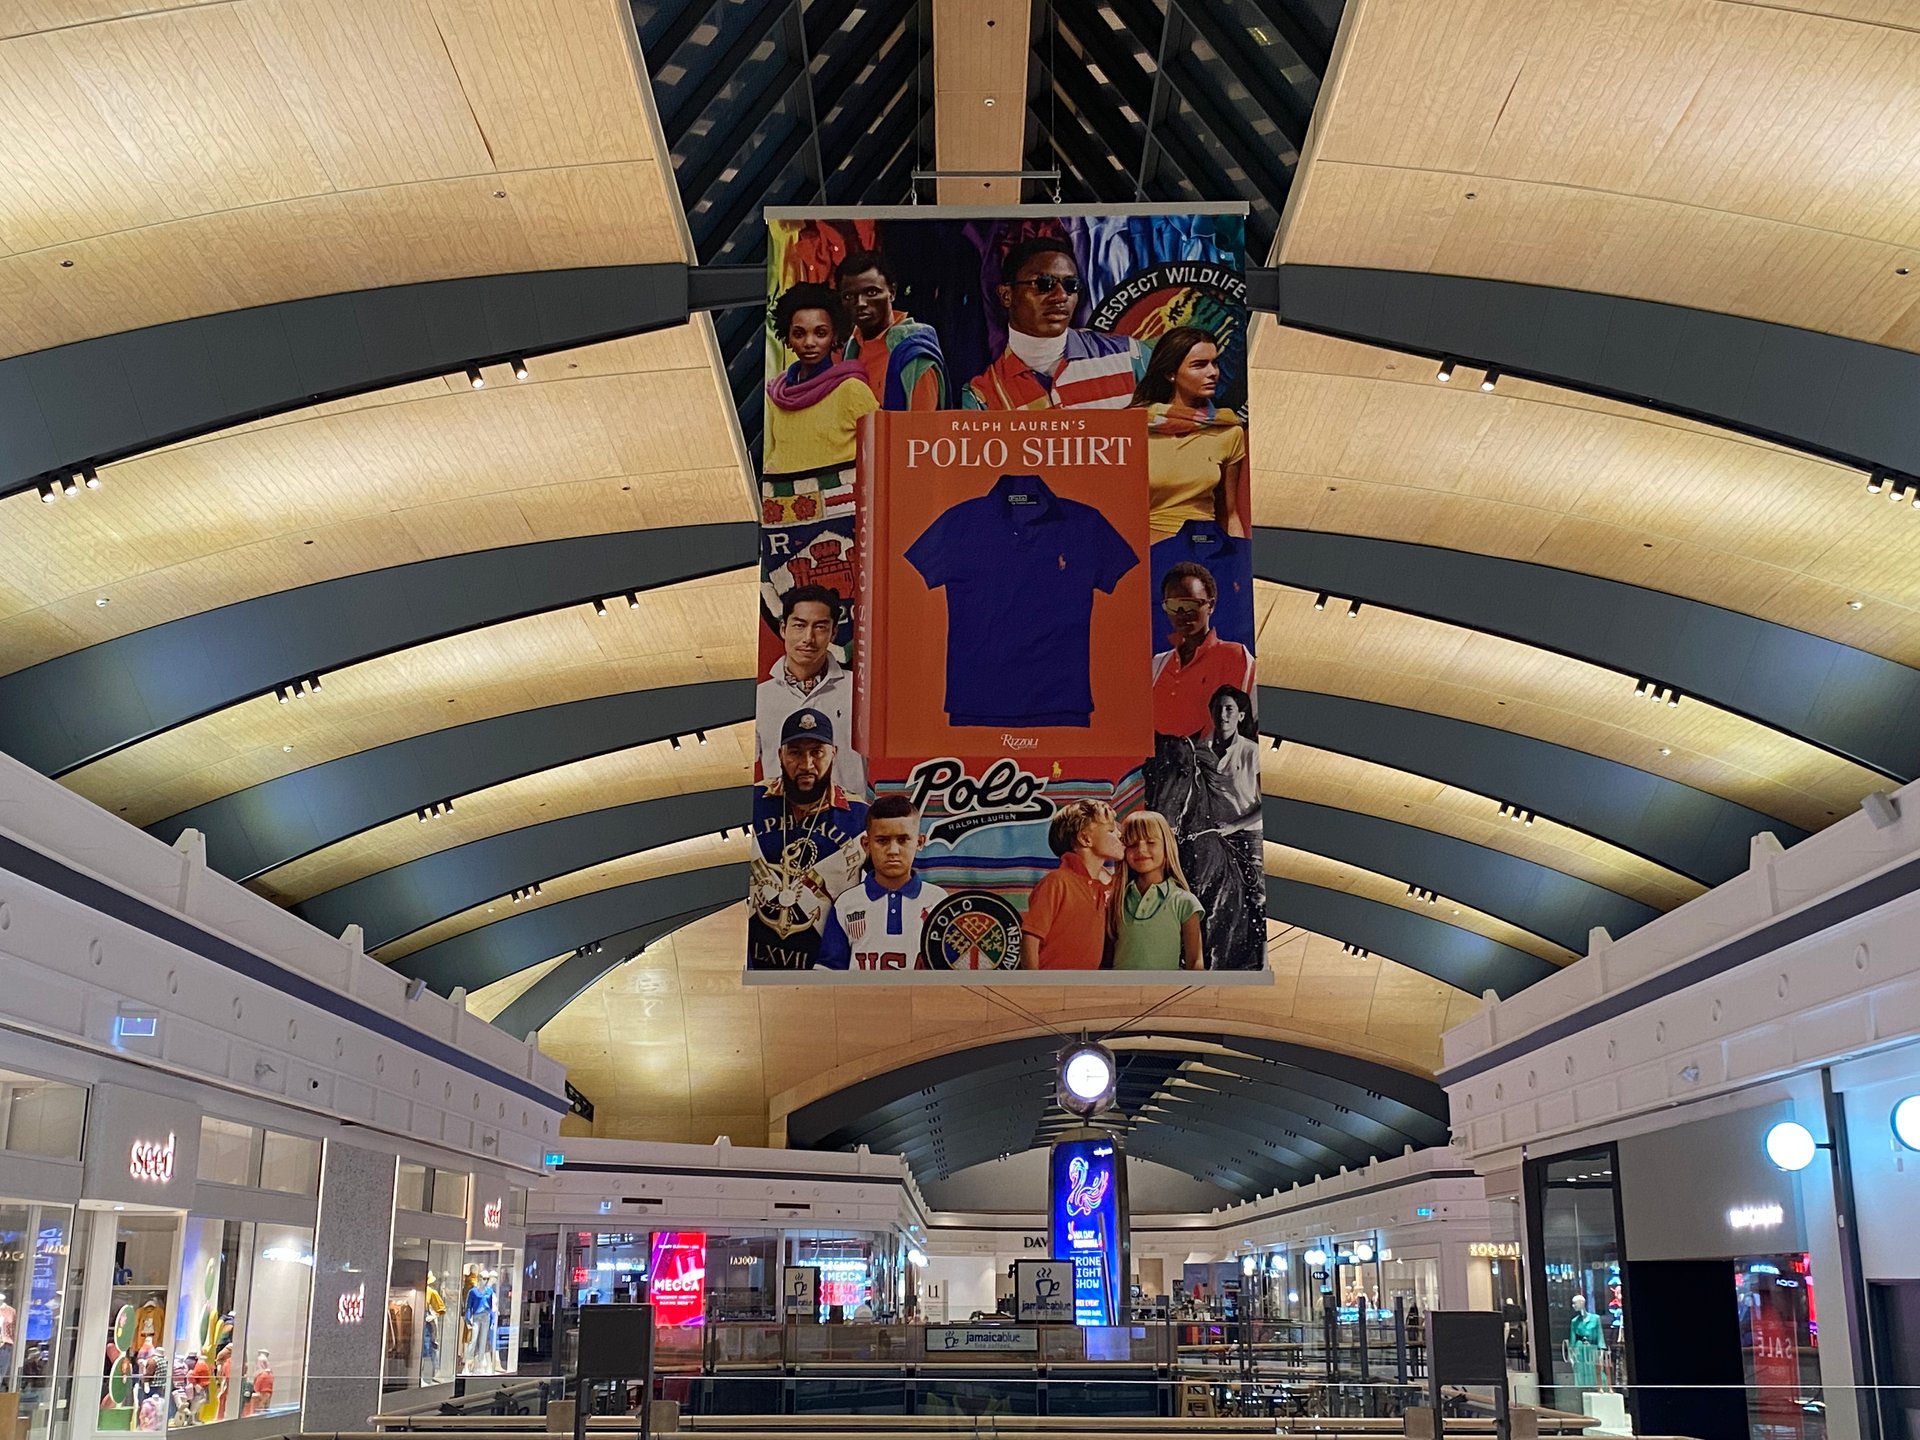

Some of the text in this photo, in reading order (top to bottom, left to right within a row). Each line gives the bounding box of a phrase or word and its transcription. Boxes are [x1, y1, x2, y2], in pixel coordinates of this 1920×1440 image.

[1094, 266, 1247, 332] RESPECT WILDLIFE
[951, 419, 1086, 432] RALPH LAUREN'S
[906, 436, 1132, 468] POLO SHIRT
[767, 532, 791, 555] R
[910, 758, 1046, 816] Polo
[948, 813, 1016, 831] RALPH LAUREN
[930, 899, 973, 941] POLO
[998, 925, 1022, 970] AUREN
[129, 1132, 177, 1182] seed
[827, 1271, 861, 1281] MECCA
[1076, 1267, 1101, 1277] IGHT
[654, 1278, 700, 1292] MECCA
[964, 1331, 1021, 1345] jamaicablue
